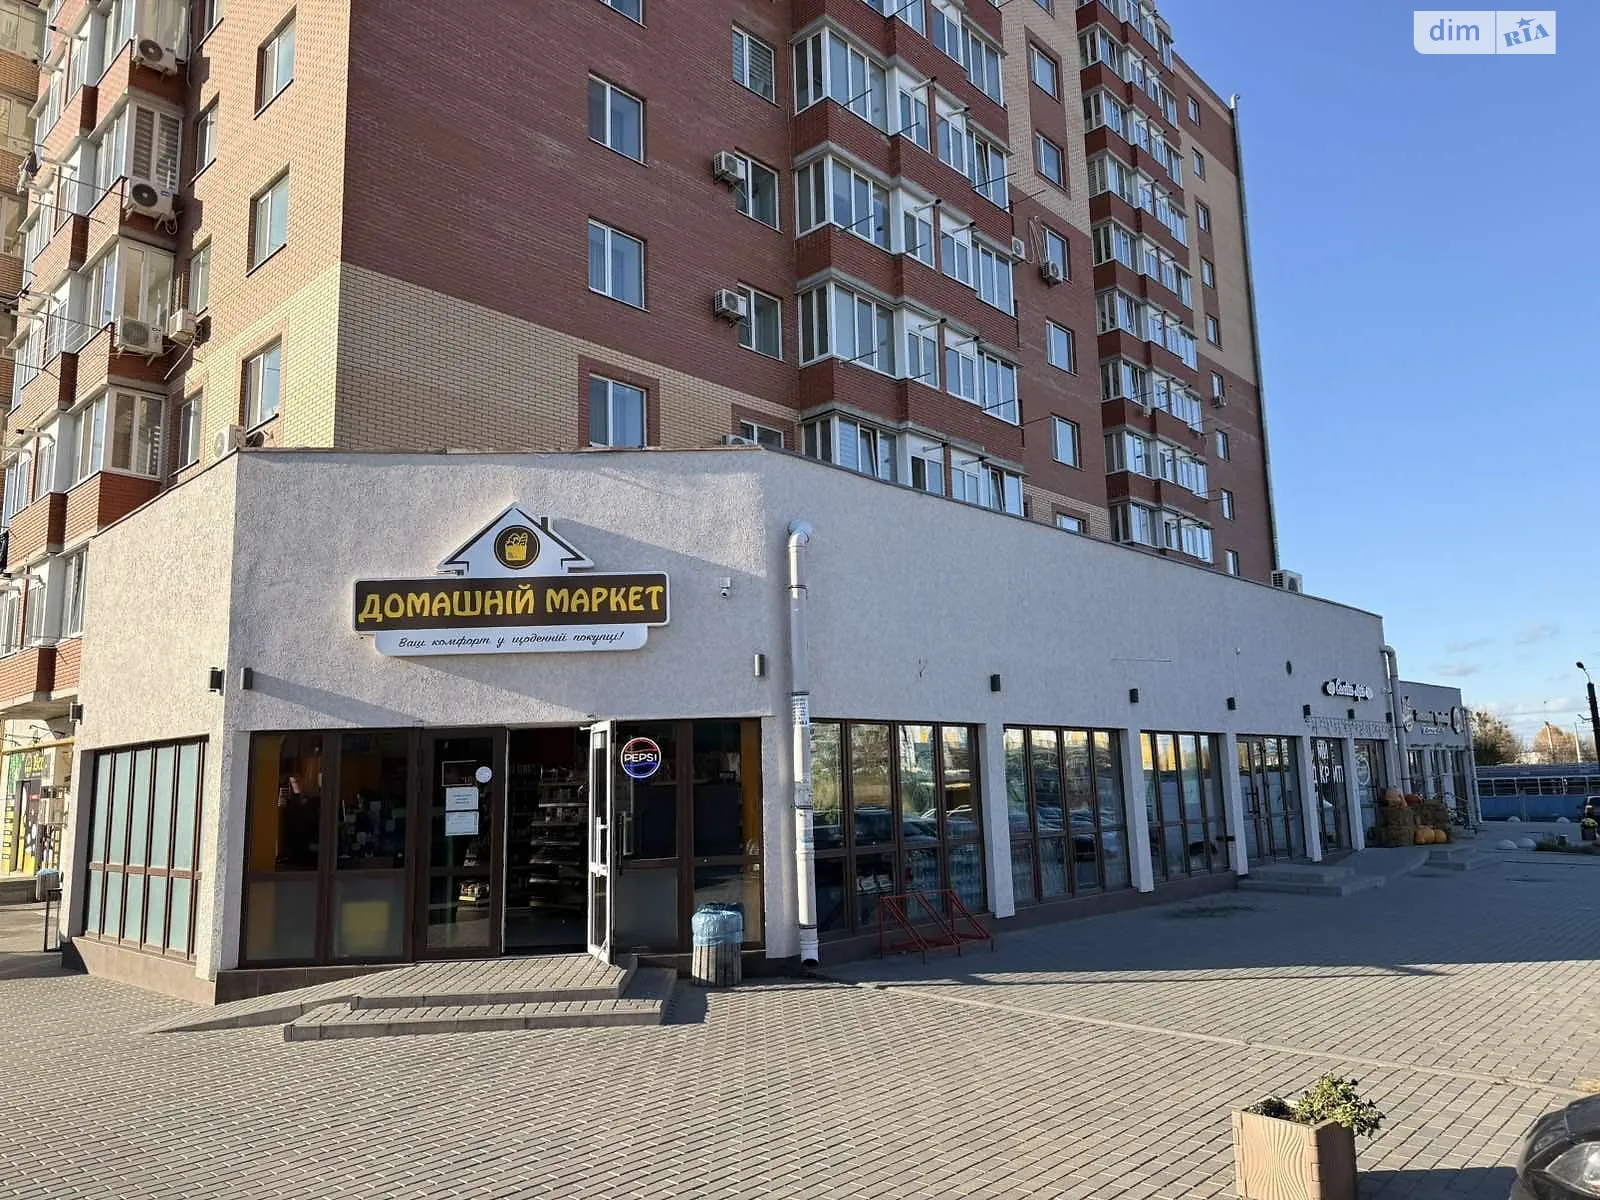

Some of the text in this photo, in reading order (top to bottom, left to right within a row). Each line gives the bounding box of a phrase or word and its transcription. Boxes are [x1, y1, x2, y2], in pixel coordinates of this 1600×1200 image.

[358, 583, 665, 623] ДОМАШНІЙ МАРКЕТ
[398, 631, 625, 649] Ваш комфорт у щоденній покупці!
[624, 752, 658, 763] PEPSI
